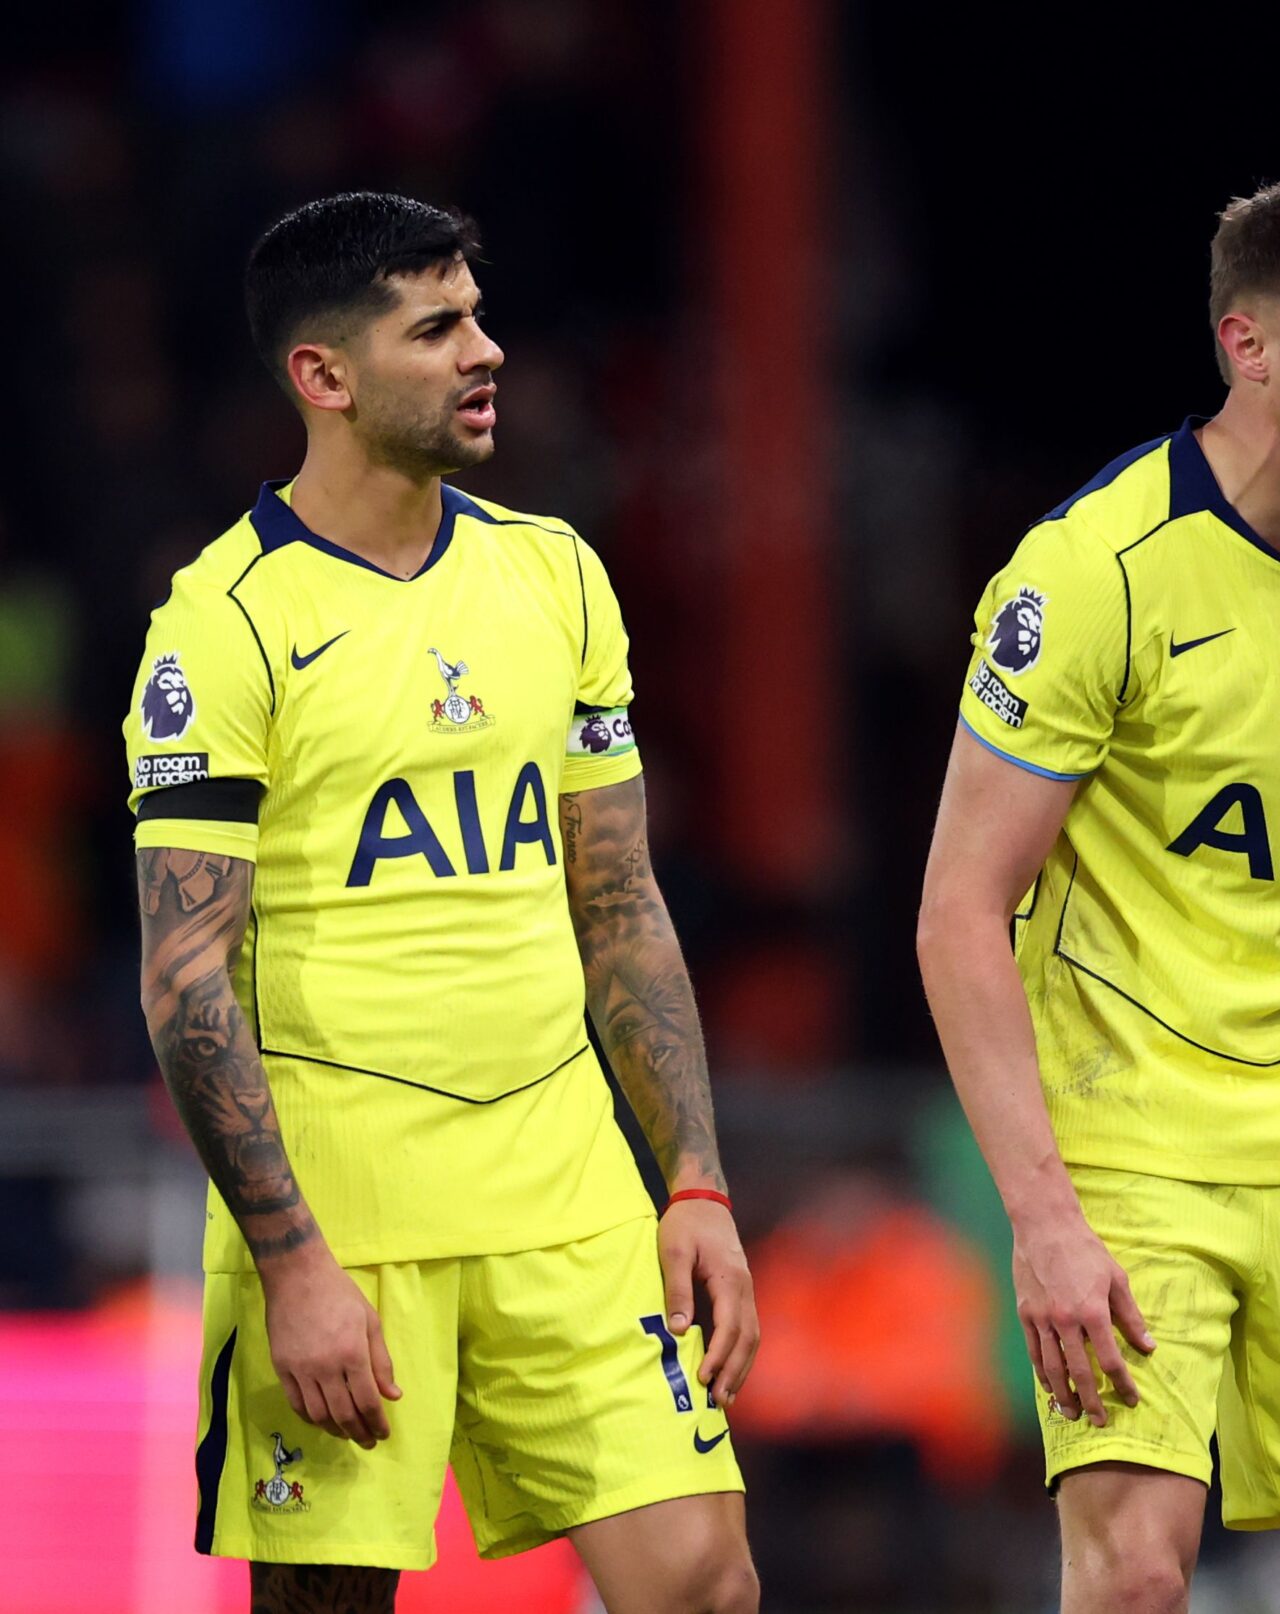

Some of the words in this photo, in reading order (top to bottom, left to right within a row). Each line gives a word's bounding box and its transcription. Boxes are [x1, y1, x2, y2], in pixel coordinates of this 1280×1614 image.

[980, 688, 1021, 728] racism
[987, 677, 1019, 713] room
[152, 770, 208, 786] racism
[153, 756, 200, 772] room
[345, 762, 557, 888] AIA
